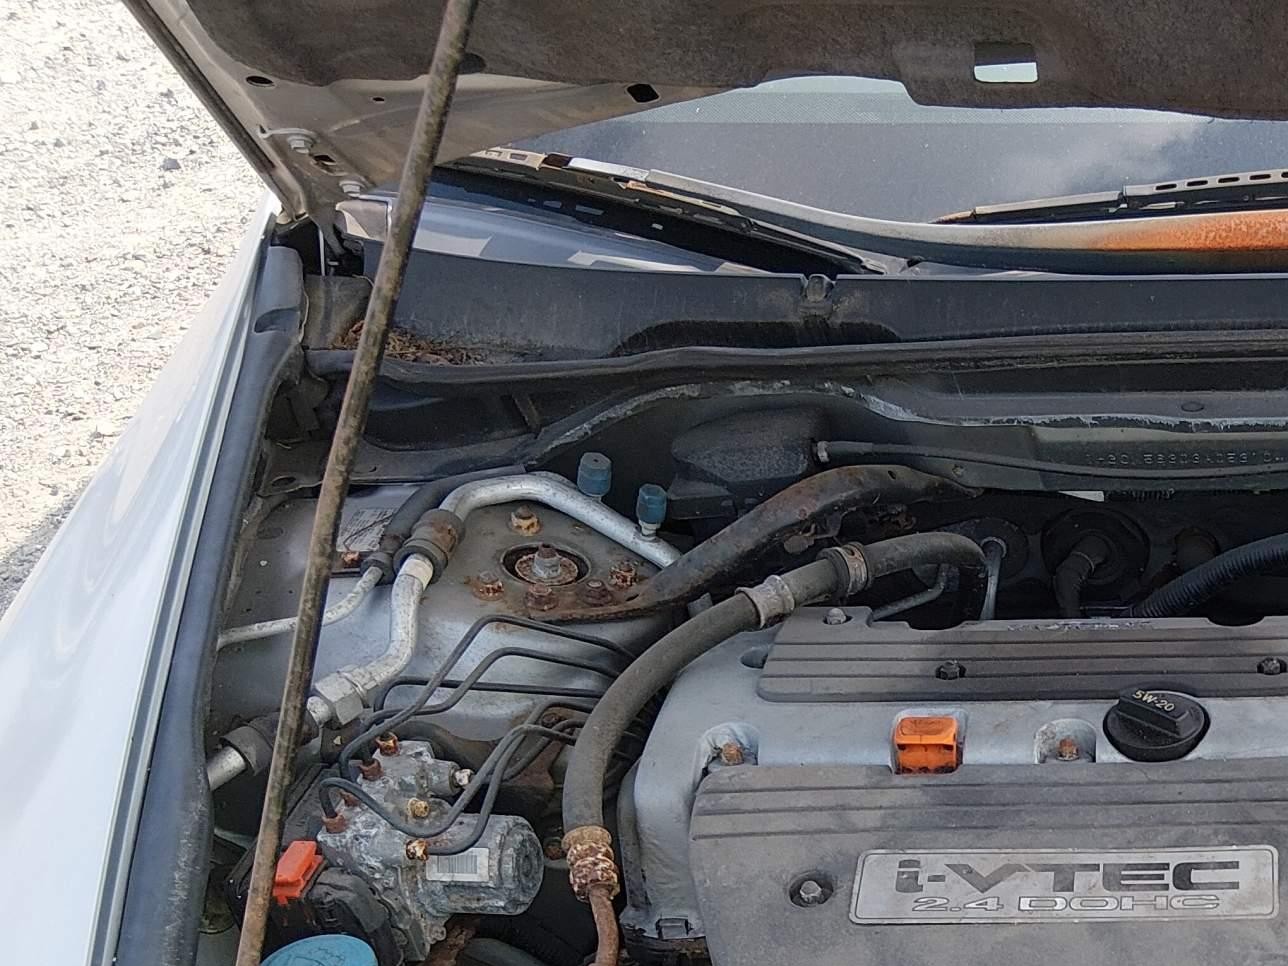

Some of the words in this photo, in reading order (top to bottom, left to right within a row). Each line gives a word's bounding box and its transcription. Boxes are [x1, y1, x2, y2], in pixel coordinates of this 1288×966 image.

[1132, 690, 1175, 712] 5W-20
[895, 858, 1241, 894] i-VTEC
[912, 896, 1004, 912] 2.4
[1017, 895, 1219, 912] DOHC
